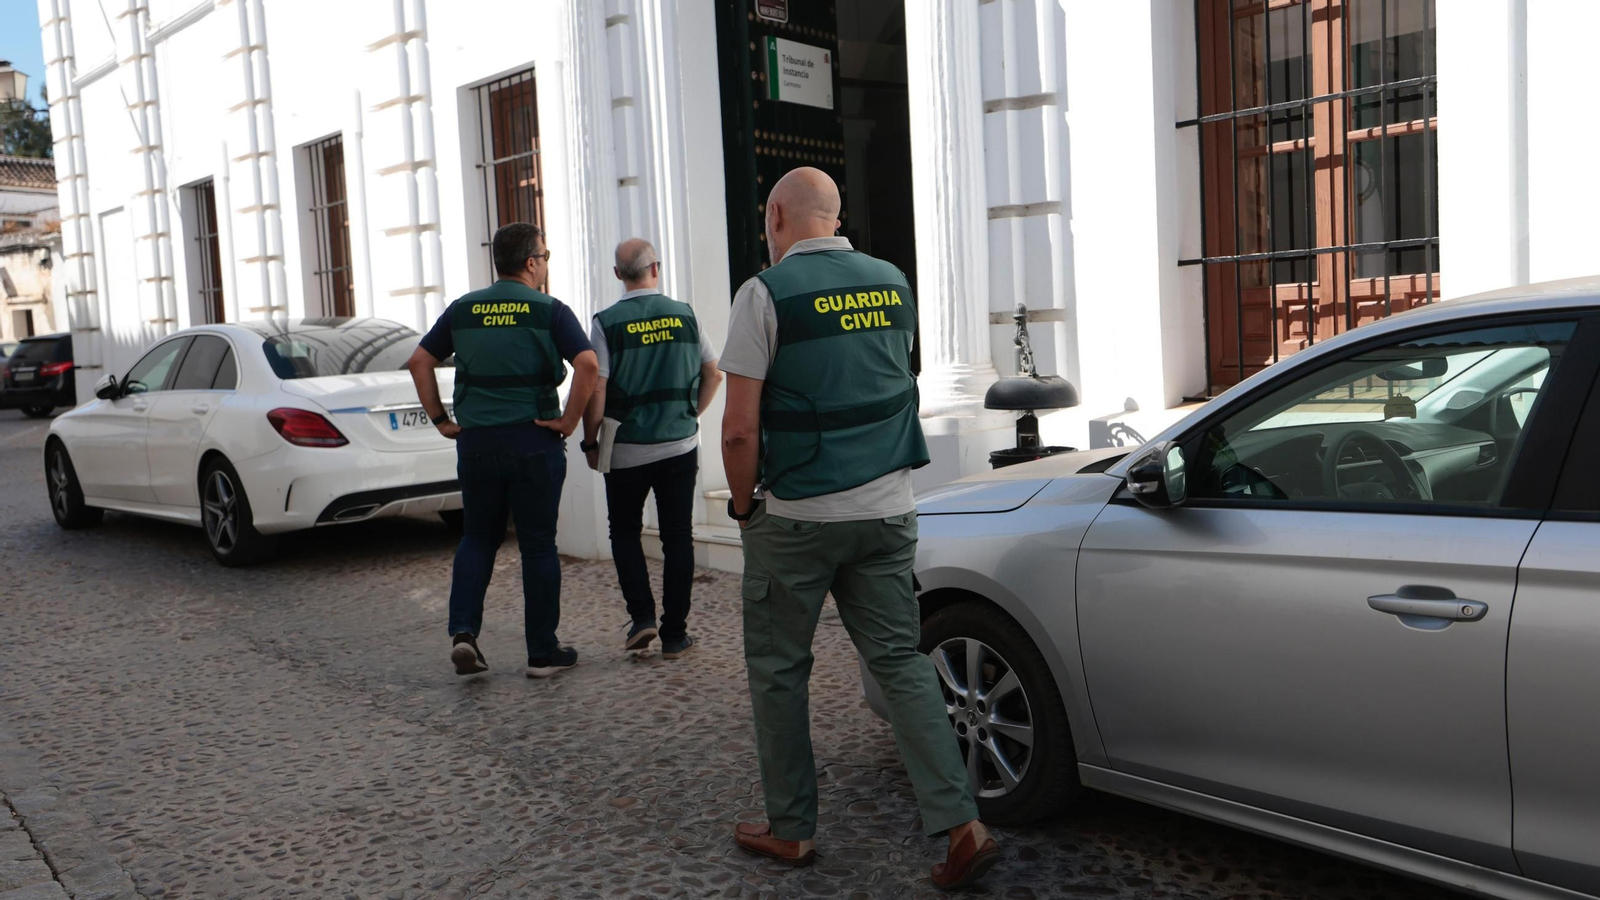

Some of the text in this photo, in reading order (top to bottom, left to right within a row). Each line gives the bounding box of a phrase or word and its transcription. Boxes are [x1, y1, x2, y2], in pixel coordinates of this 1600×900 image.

[782, 54, 815, 68] Tribunal de
[783, 67, 809, 79] Instancia
[471, 303, 530, 314] GUARDIA
[814, 290, 902, 314] GUARDIA
[483, 315, 517, 326] CIVIL
[627, 318, 683, 334] GUARDIA
[840, 311, 891, 331] CIVIL
[642, 330, 674, 344] CIVIL
[402, 411, 428, 426] 478
